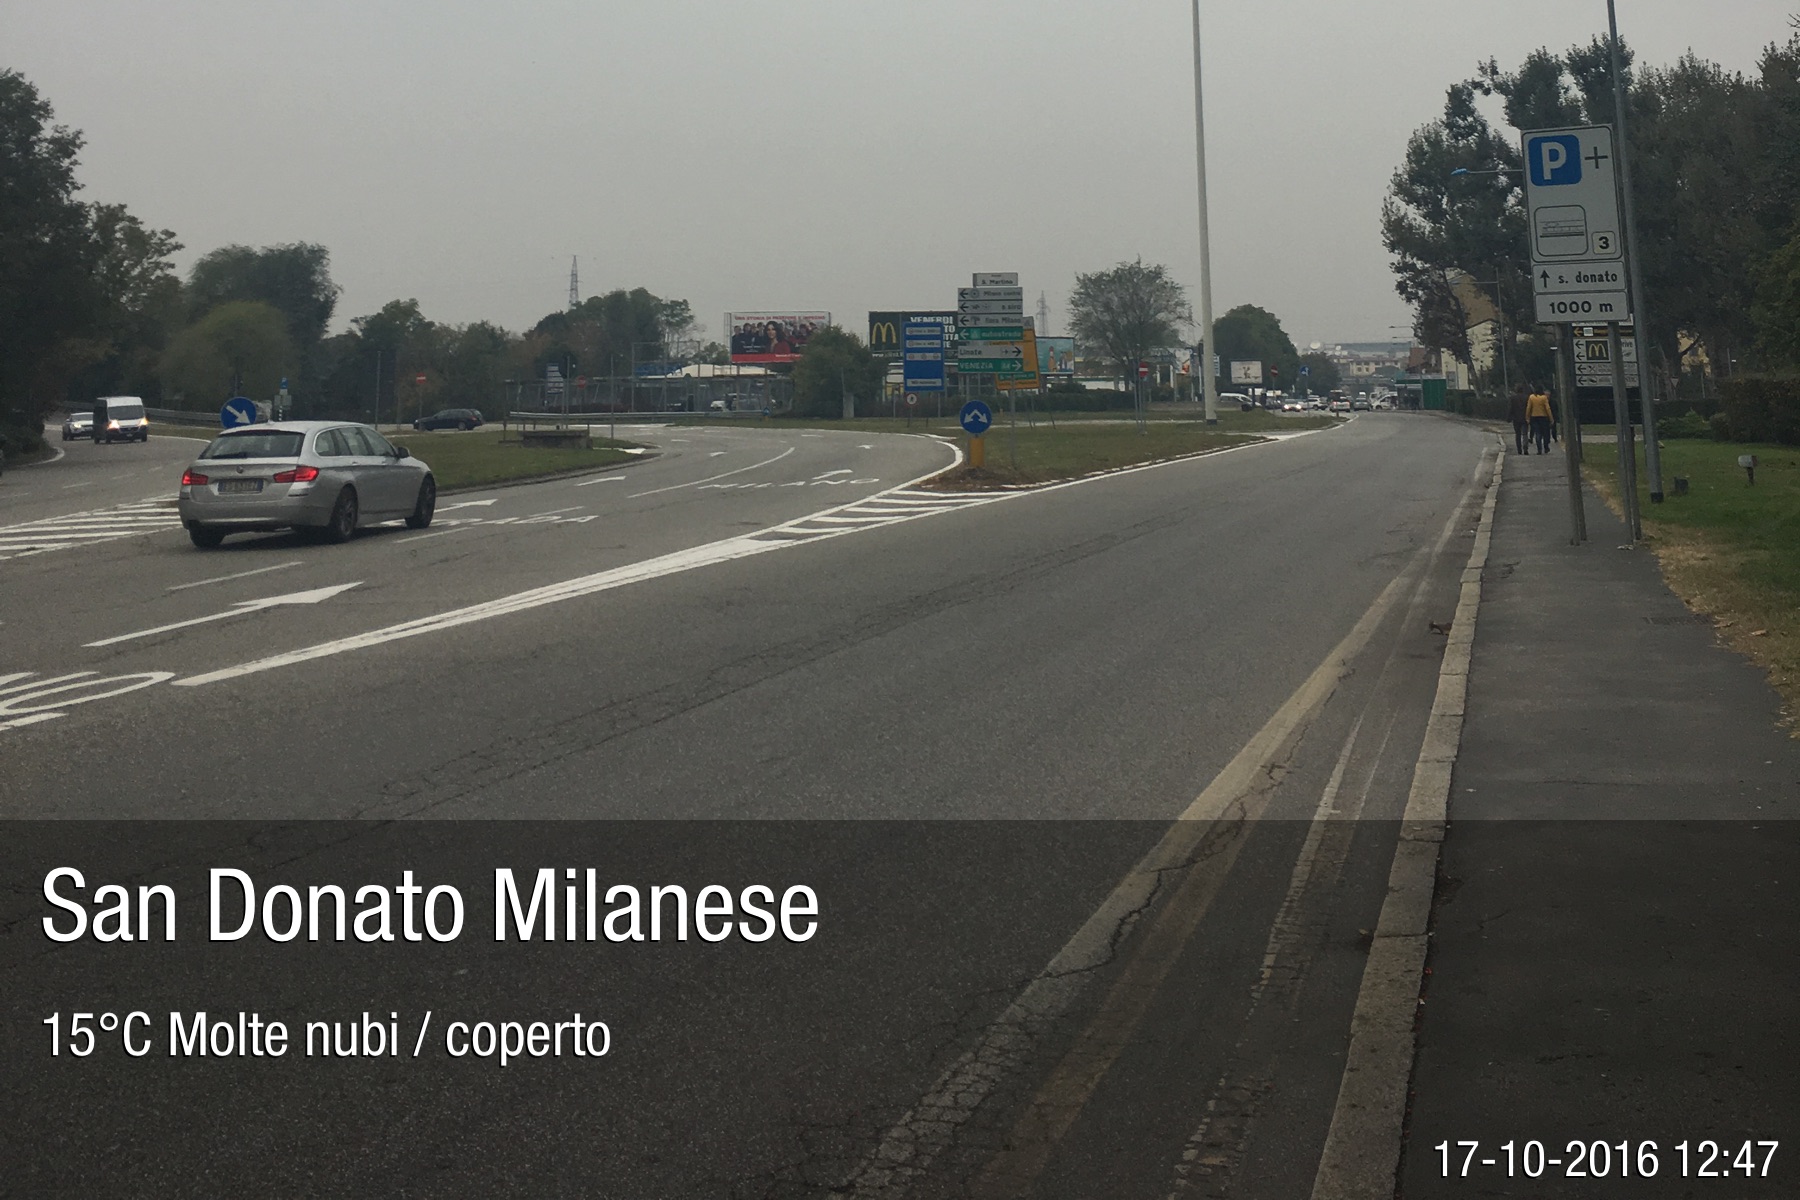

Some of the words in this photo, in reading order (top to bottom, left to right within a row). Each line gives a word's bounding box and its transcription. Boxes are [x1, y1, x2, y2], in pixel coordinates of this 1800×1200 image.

[1541, 141, 1566, 180] P
[1598, 236, 1610, 250] 3
[1558, 275, 1569, 285] s.
[1575, 271, 1618, 284] donato
[1549, 300, 1593, 315] 1000
[1599, 302, 1614, 313] m
[959, 362, 994, 370] VENEZIA
